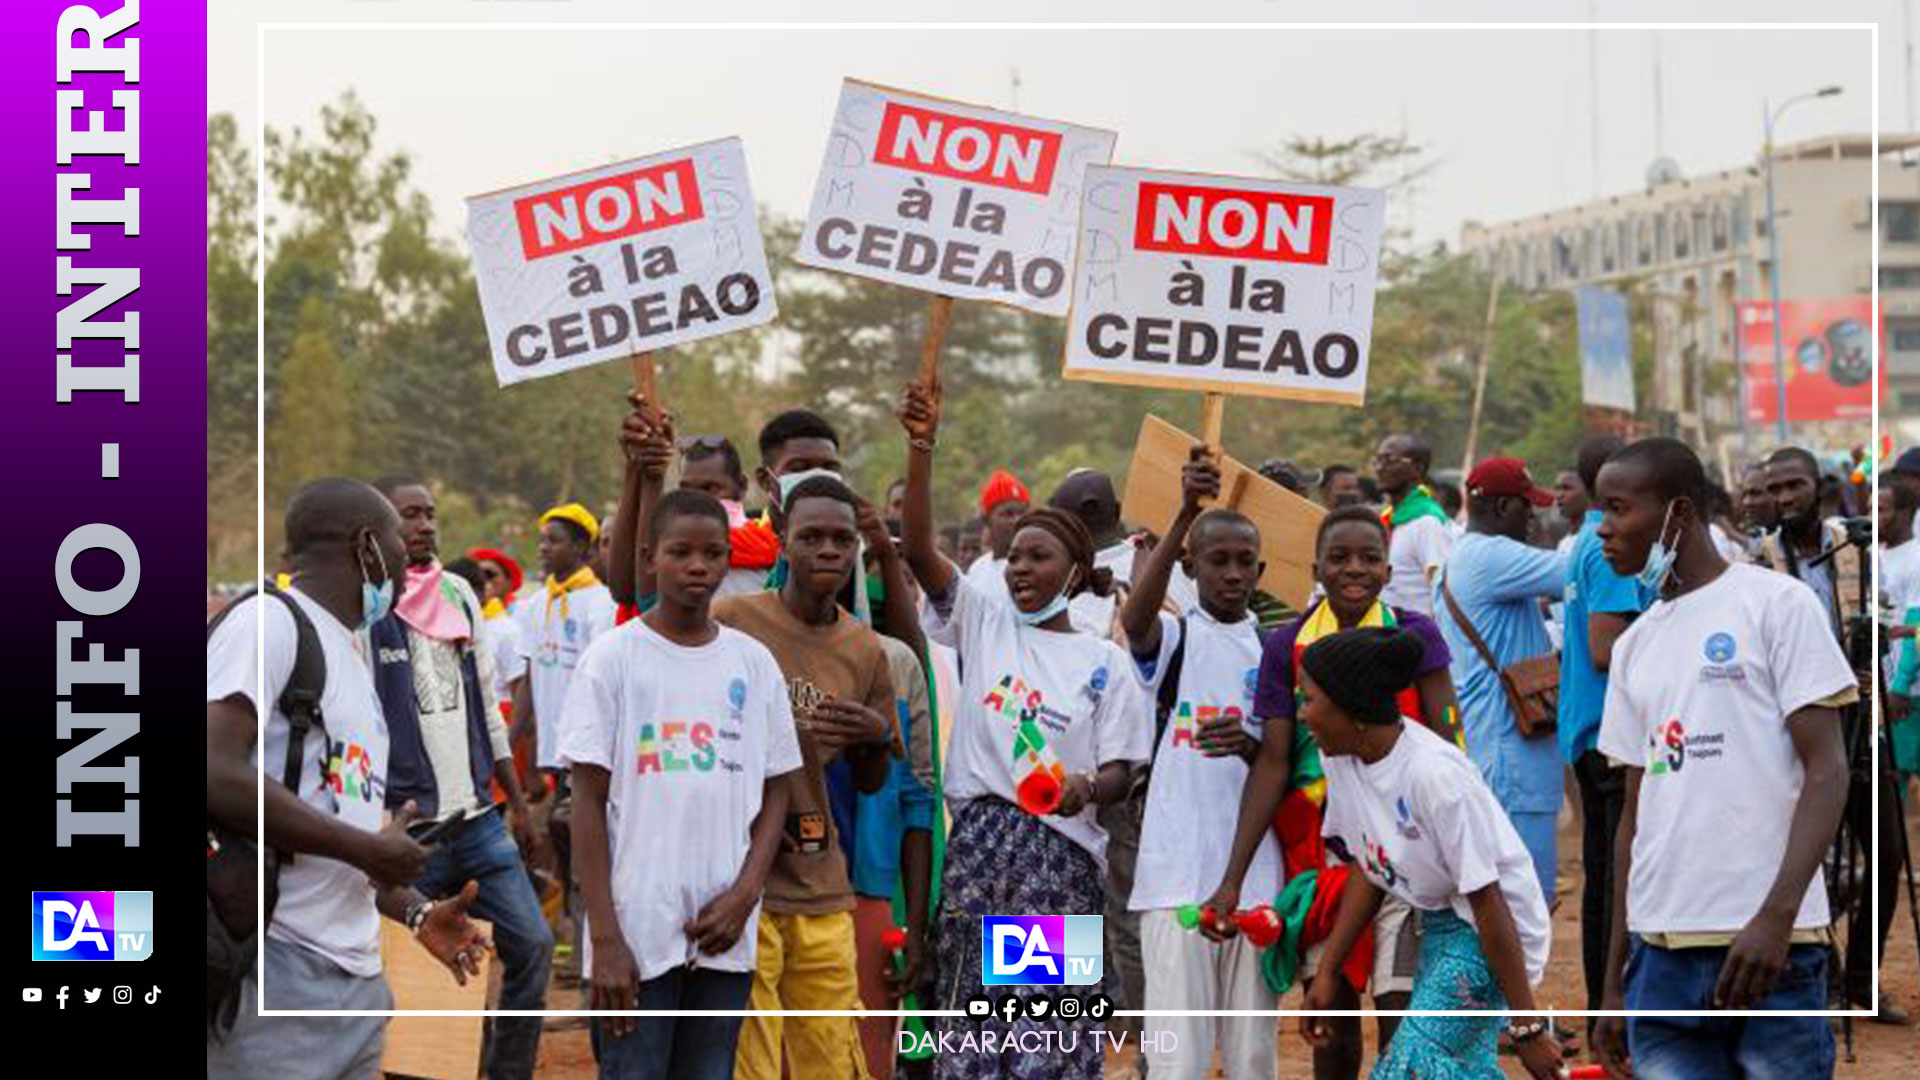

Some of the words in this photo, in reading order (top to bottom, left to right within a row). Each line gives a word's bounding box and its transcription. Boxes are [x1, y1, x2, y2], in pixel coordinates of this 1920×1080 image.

[890, 114, 1044, 184] NON
[531, 170, 685, 249] NON
[898, 178, 932, 221] à
[953, 188, 1006, 234] la
[1153, 193, 1314, 254] NON
[568, 255, 604, 298] à
[620, 243, 678, 285] la
[816, 218, 1064, 299] CEDEAO
[1167, 259, 1205, 307] à
[1229, 265, 1285, 314] la
[506, 272, 760, 367] CEDEAO
[1086, 313, 1360, 379] CEDEAO
[637, 722, 716, 774] AES
